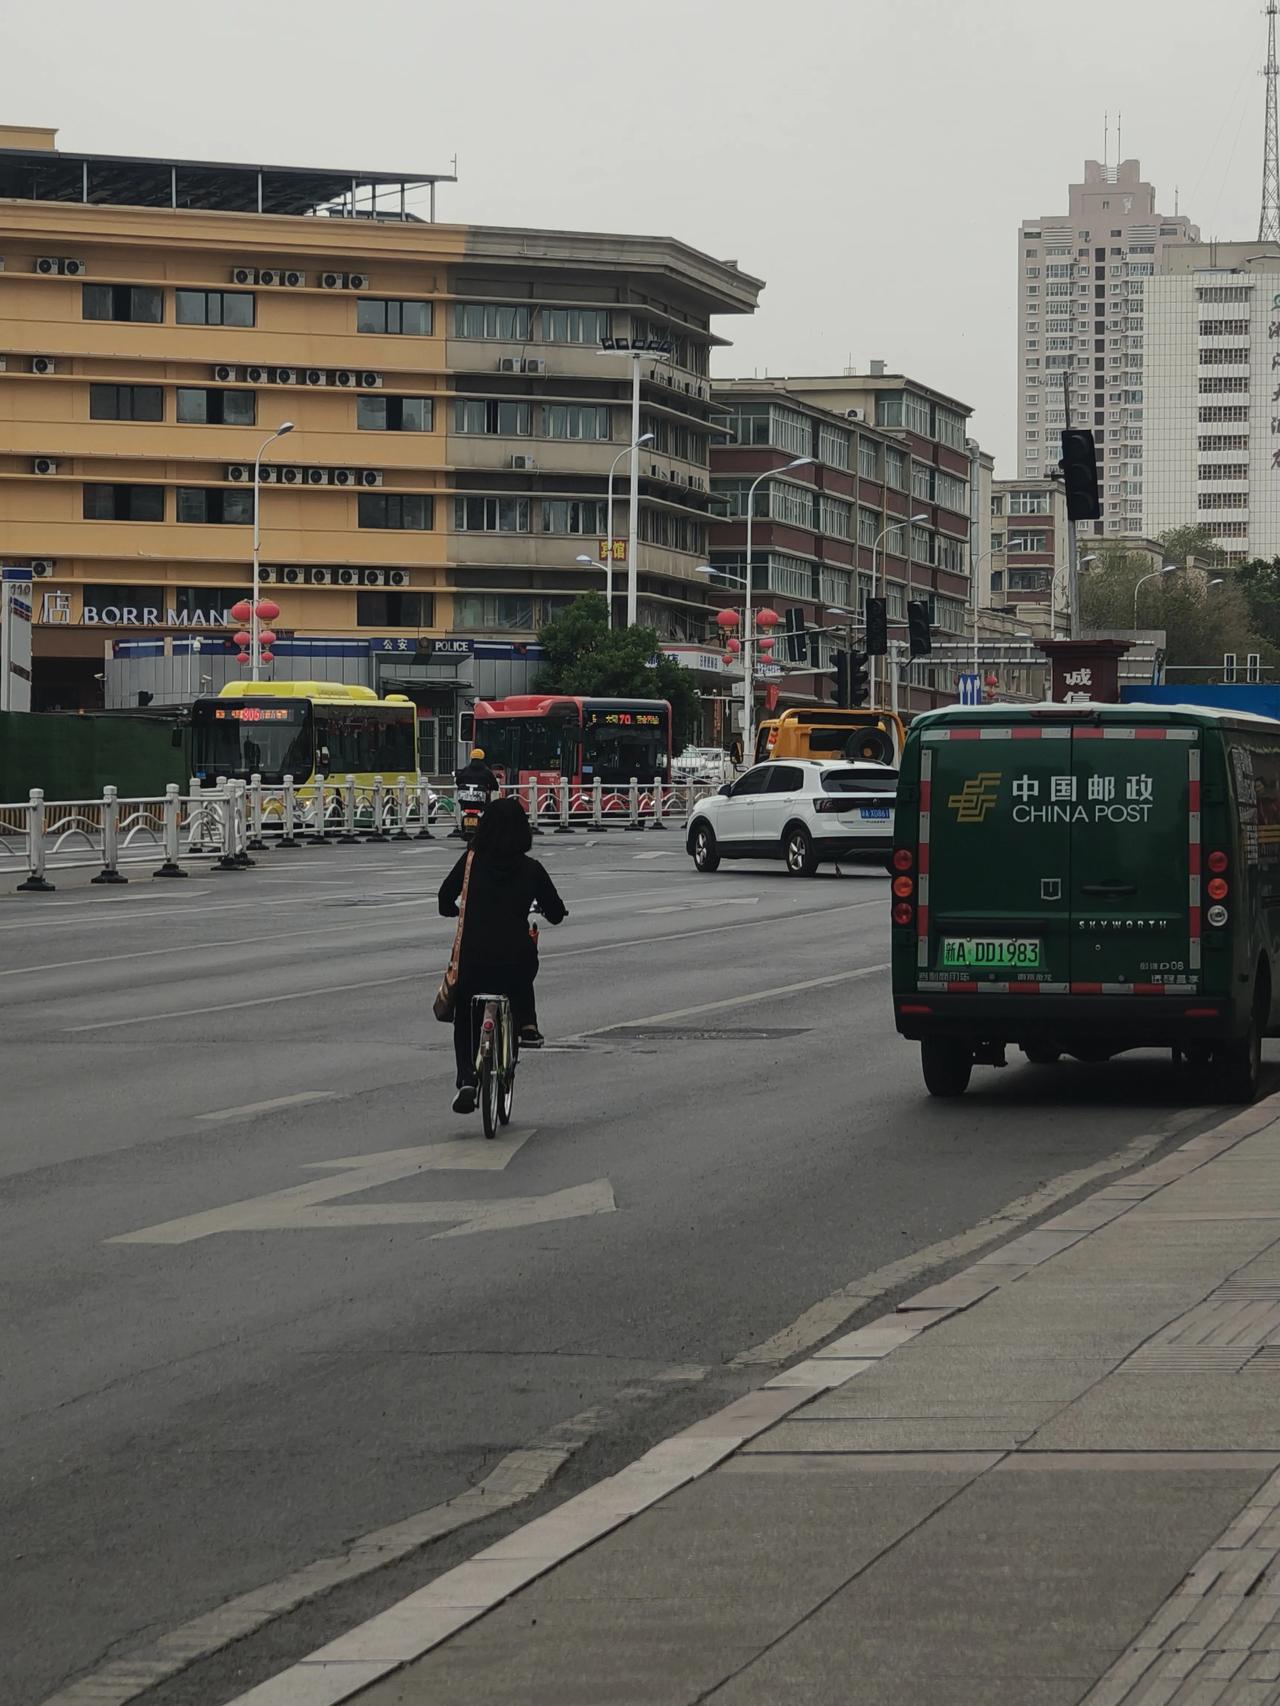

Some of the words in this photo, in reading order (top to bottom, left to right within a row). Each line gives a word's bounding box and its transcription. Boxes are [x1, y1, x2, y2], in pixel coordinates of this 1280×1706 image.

[600, 540, 625, 559] 宾馆
[10, 584, 31, 595] 110
[43, 590, 72, 624] 店
[383, 638, 408, 650] 公安
[435, 641, 469, 651] POLICE
[1012, 773, 1153, 802] 中国邮政
[1012, 804, 1088, 823] CHINA
[1095, 804, 1153, 823] POST
[1078, 920, 1167, 929] SKYWORTH
